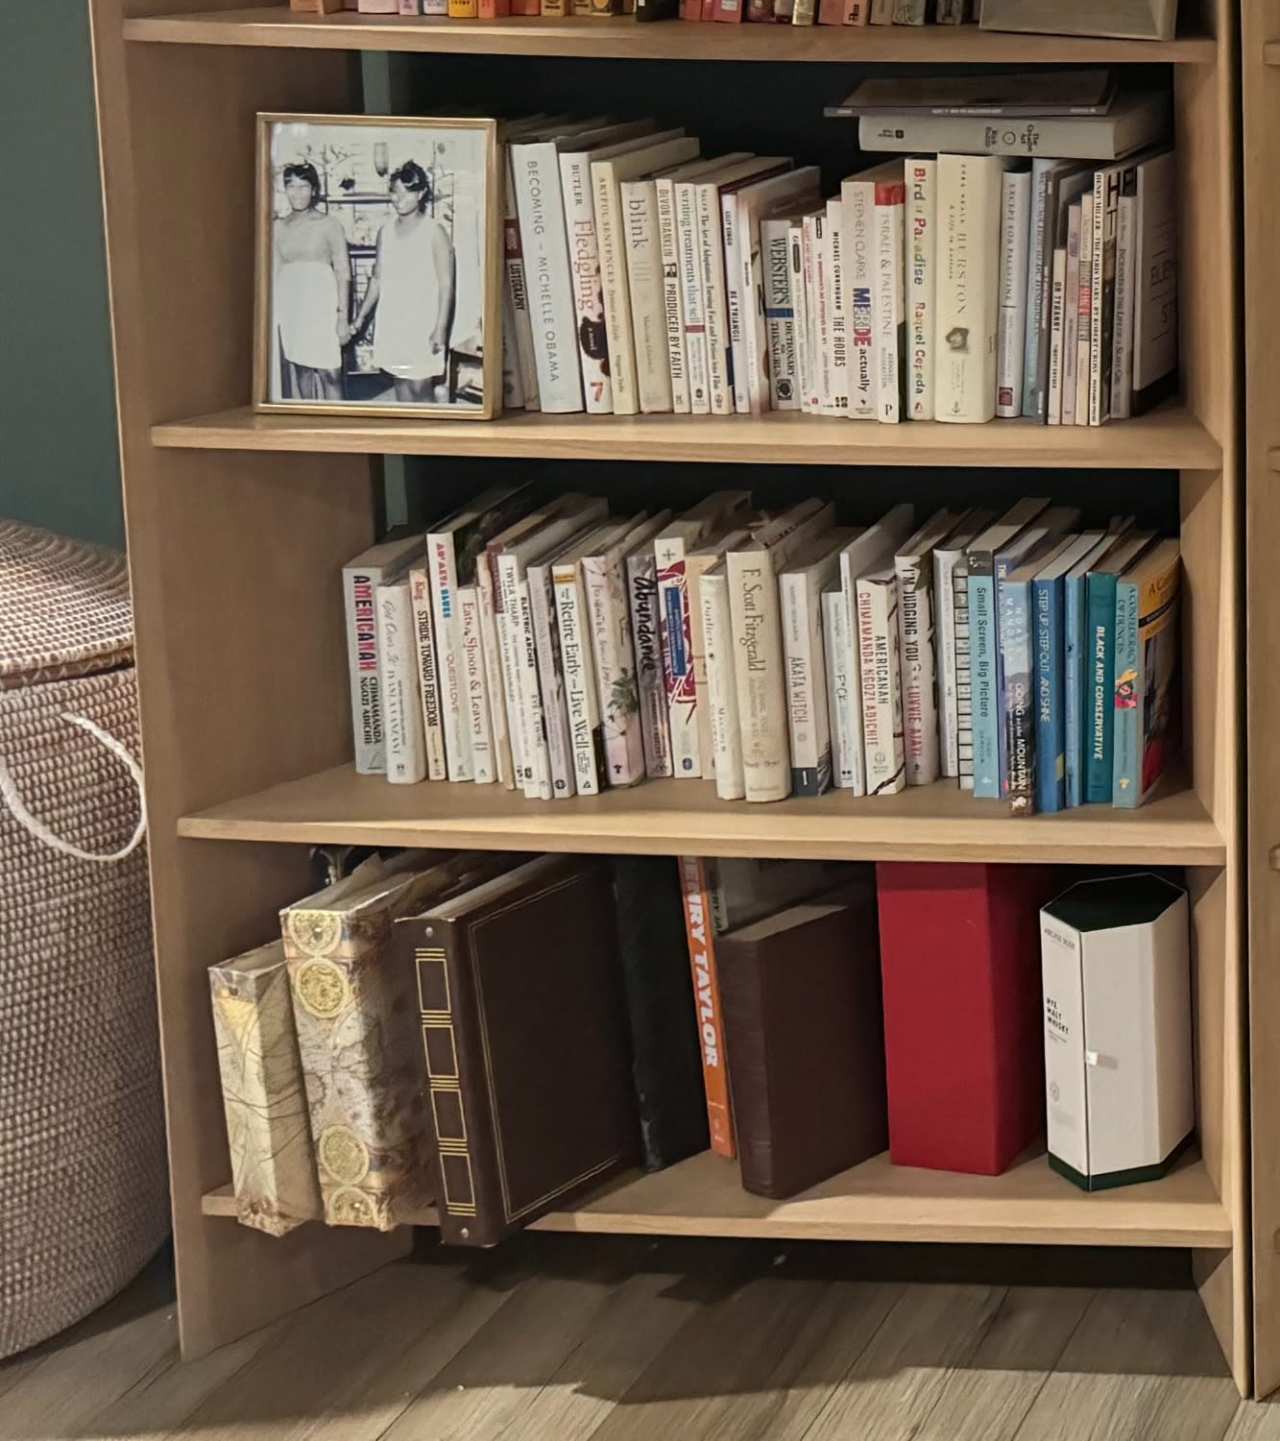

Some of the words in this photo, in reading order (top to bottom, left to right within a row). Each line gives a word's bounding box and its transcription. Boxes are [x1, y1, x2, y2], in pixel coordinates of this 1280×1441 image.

[527, 160, 544, 236] BECOMING
[570, 164, 583, 206] BUTLER
[628, 199, 649, 250] blink
[573, 219, 598, 312] Fledgling
[770, 237, 790, 306] WEBSTER'S
[537, 256, 556, 325] MICHELLE
[545, 330, 560, 383] OBAMA
[741, 568, 760, 579] F.
[743, 582, 761, 612] Scott
[975, 587, 988, 617] Small
[352, 574, 377, 671] AMERICANAH
[417, 610, 432, 643] STRIDE
[560, 600, 578, 641] Retire
[975, 619, 989, 658] Screen,
[561, 643, 580, 678] Early
[740, 615, 766, 672] Fitzgerald
[1094, 625, 1106, 658] BLACK
[420, 644, 435, 682] TOWARD
[976, 660, 990, 678] Big
[1094, 661, 1106, 683] AND
[423, 683, 438, 727] FREEDOM
[567, 690, 583, 718] Live
[977, 681, 991, 719] Picture
[571, 719, 588, 750] Well
[1093, 685, 1106, 761] CONSERVATIVE
[694, 950, 720, 1068] TAYLOR
